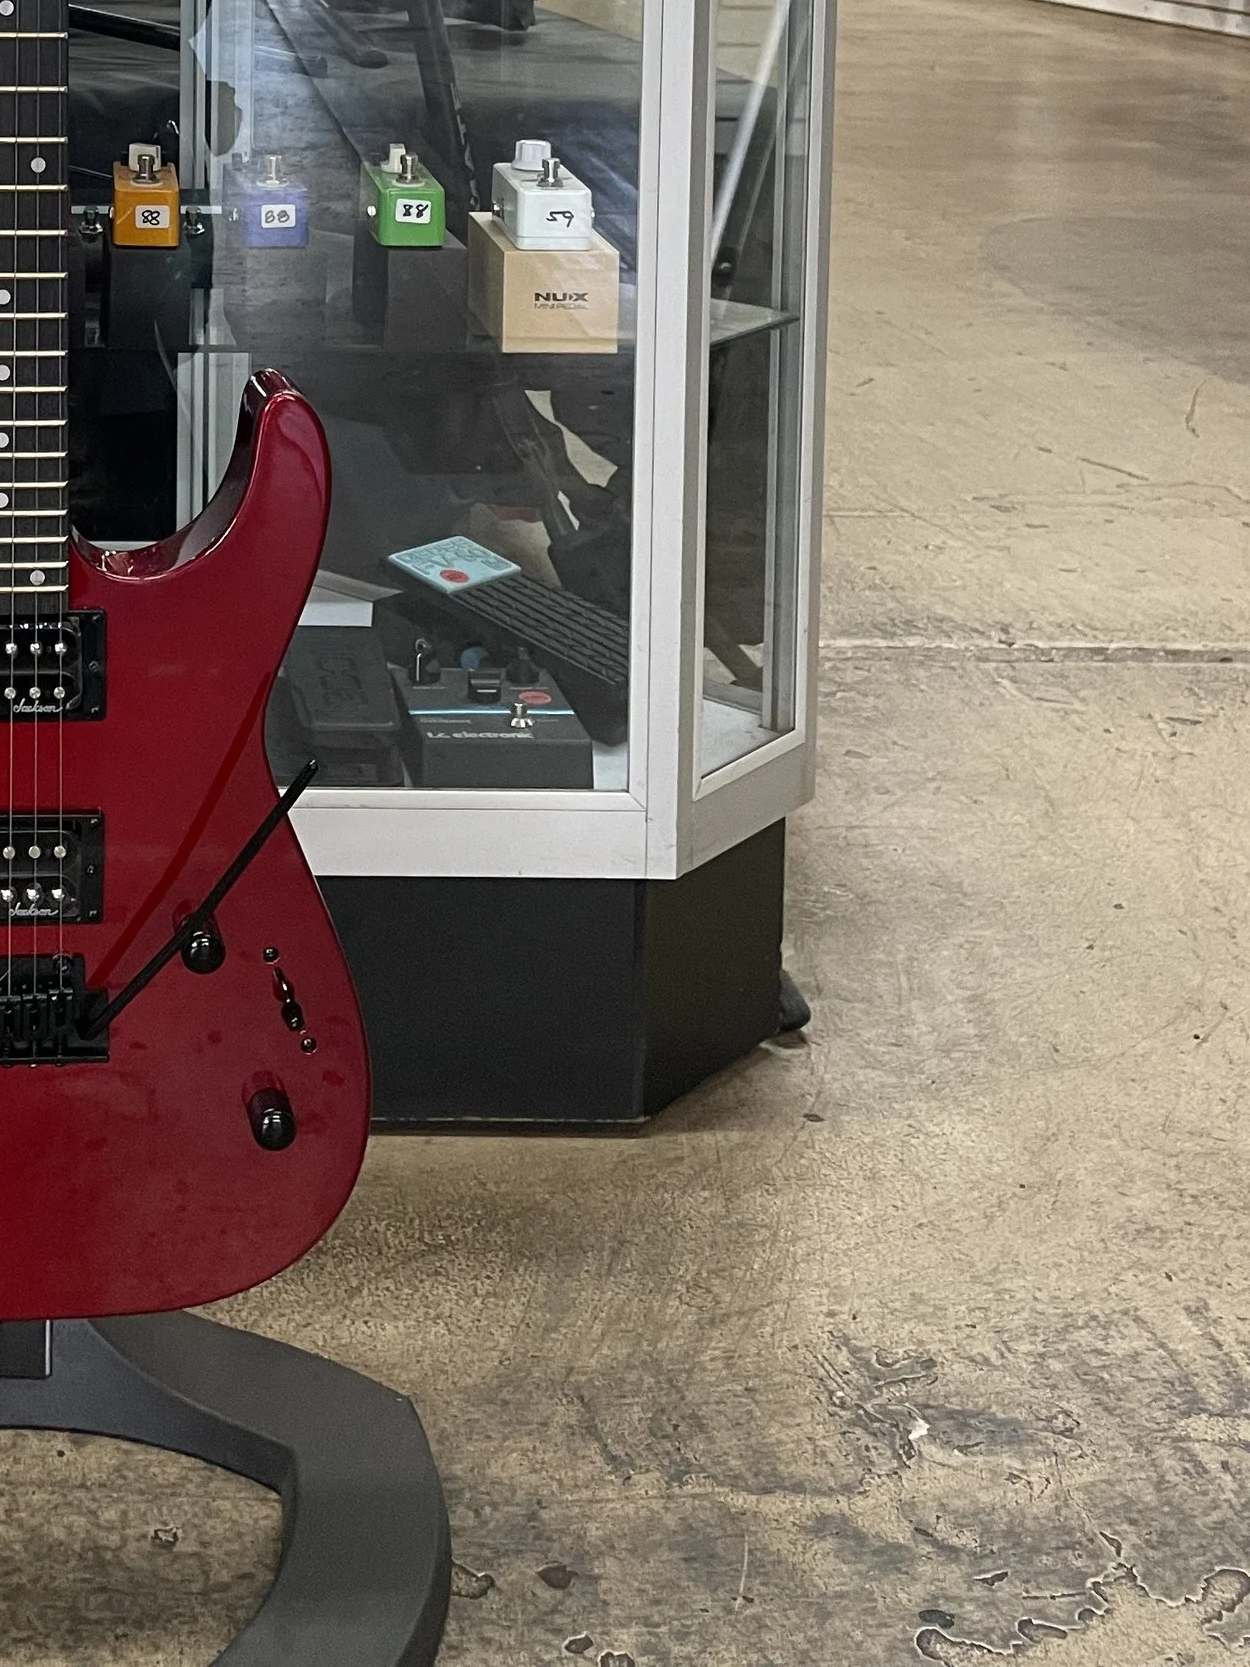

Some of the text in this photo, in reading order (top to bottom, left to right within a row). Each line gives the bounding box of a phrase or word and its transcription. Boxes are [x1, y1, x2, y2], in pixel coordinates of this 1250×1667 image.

[546, 210, 575, 228] 59
[534, 292, 589, 302] NUX
[13, 697, 63, 714] Jackson
[452, 730, 534, 739] electronic
[9, 901, 59, 917] Jackson
